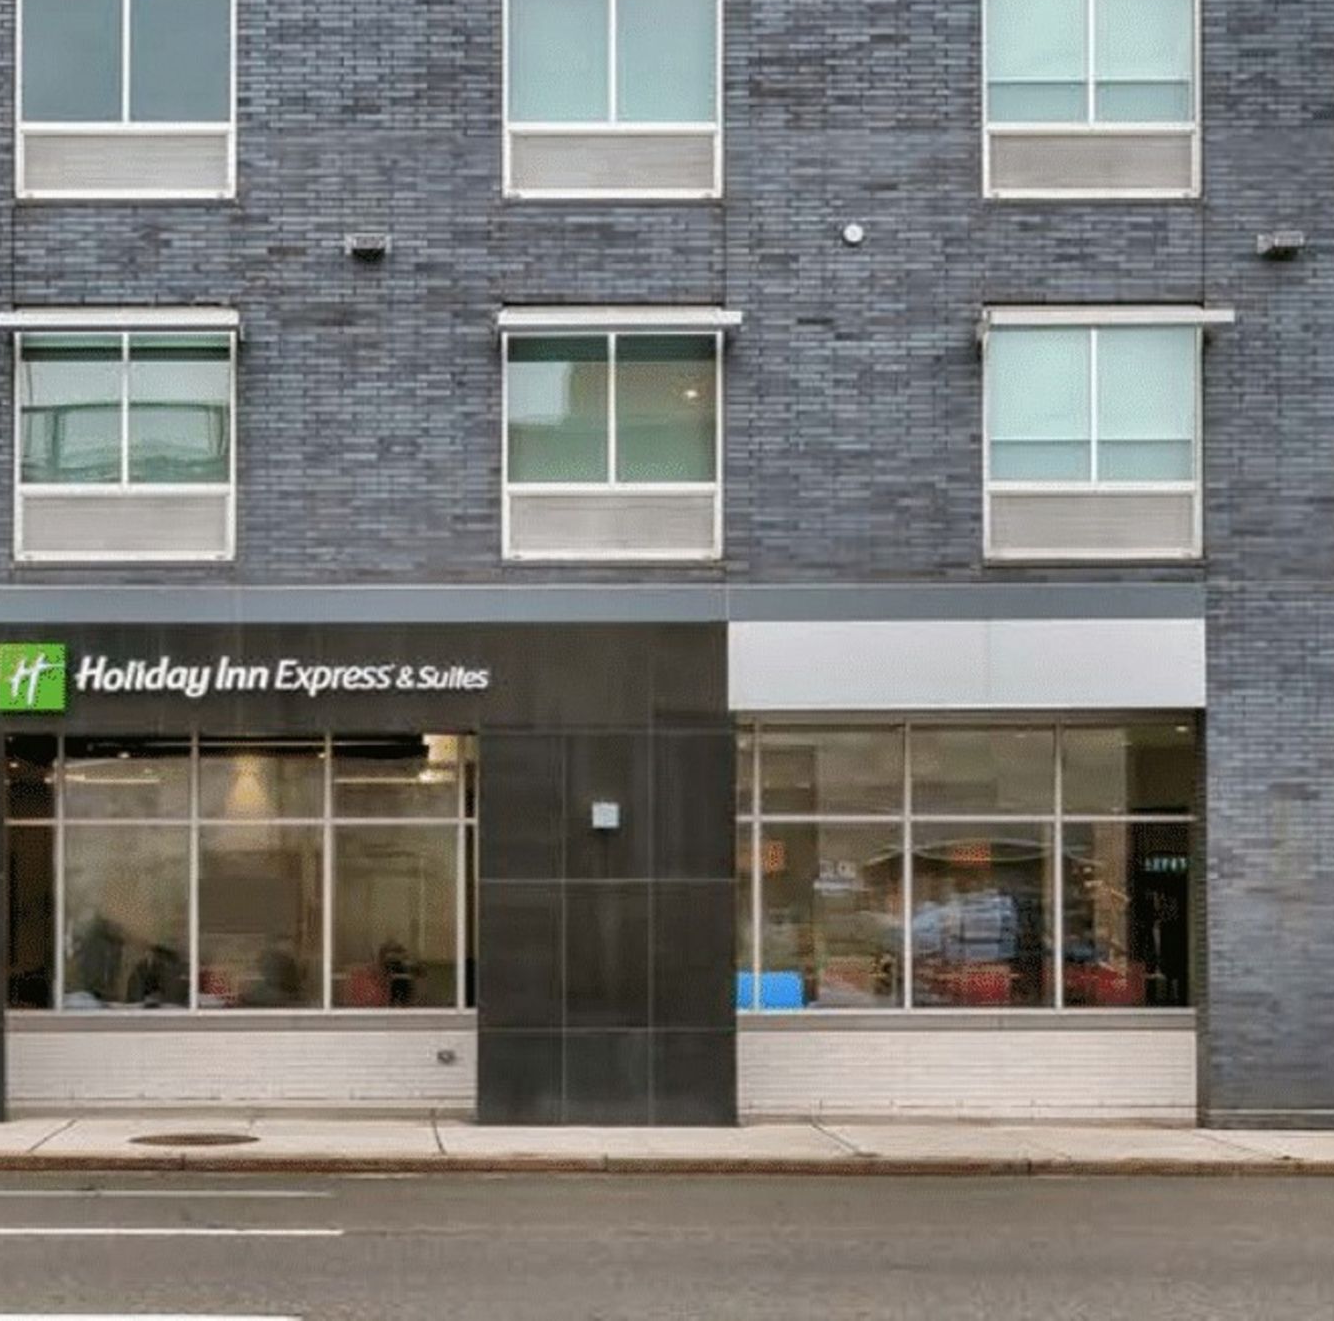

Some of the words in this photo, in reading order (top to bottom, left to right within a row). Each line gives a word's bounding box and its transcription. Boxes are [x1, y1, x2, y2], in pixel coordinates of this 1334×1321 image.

[75, 655, 211, 698] Holiday
[215, 655, 269, 691] Inn
[274, 658, 394, 698] Express
[395, 664, 414, 690] &
[416, 664, 489, 690] Suites
